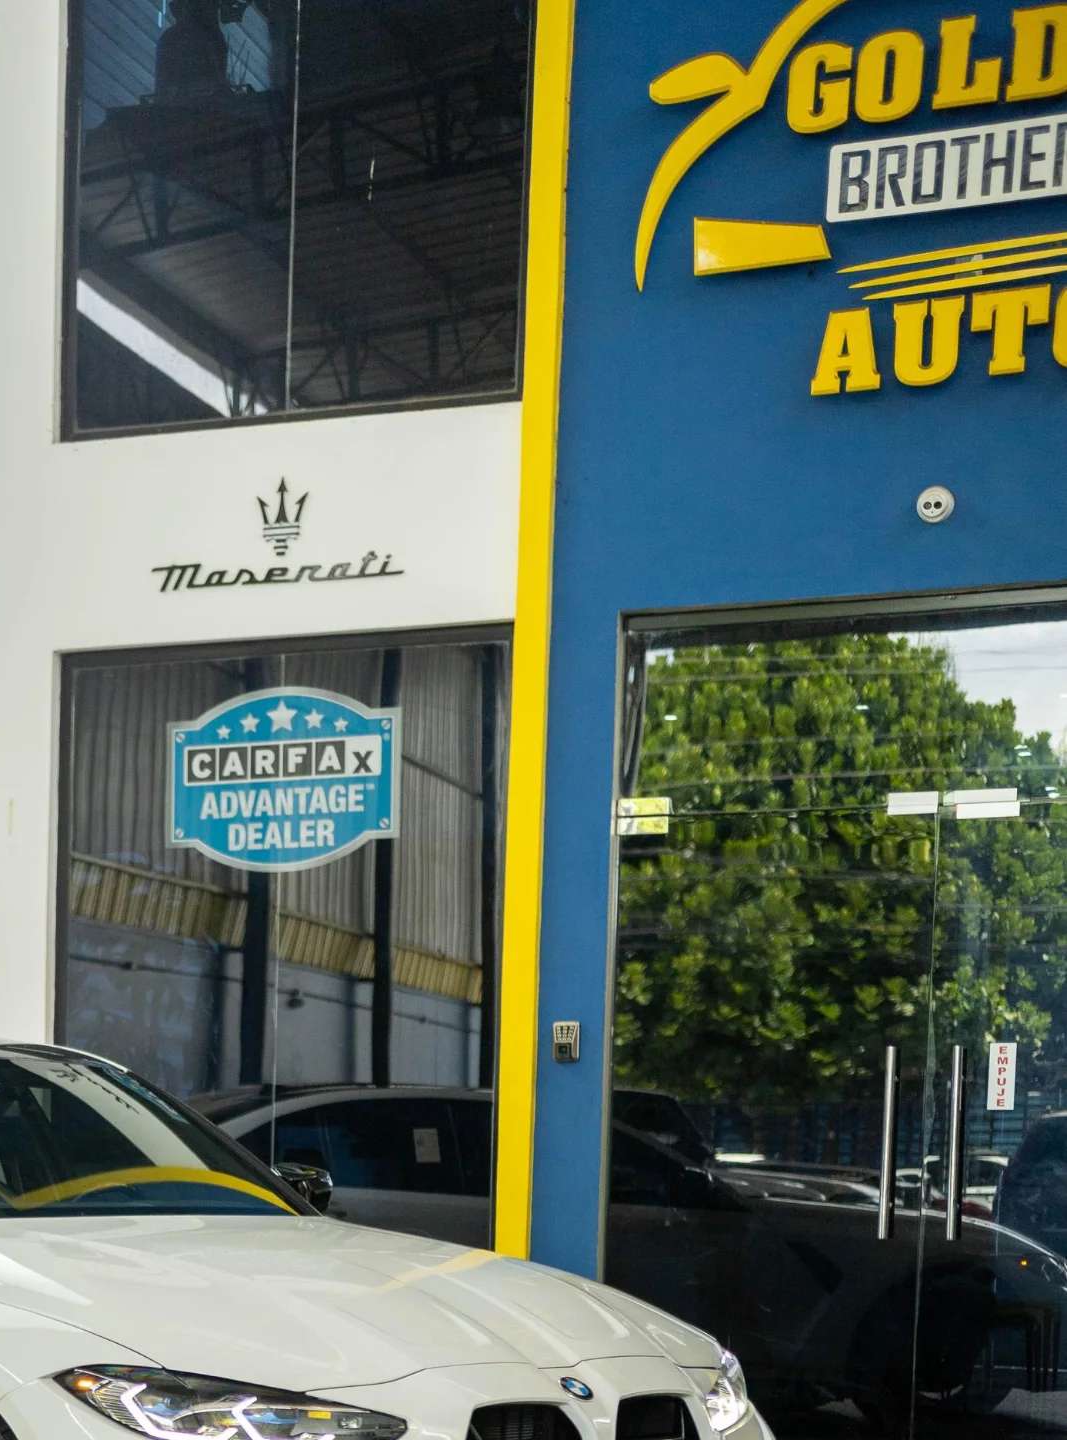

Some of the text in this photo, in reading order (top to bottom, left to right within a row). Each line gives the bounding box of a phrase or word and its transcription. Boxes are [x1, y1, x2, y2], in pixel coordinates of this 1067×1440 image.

[810, 283, 1067, 397] AUT
[151, 550, 405, 593] Maserati
[190, 746, 375, 780] CARFAX
[199, 783, 365, 821] ADVANTAGE
[227, 819, 335, 852] DEALER
[996, 1045, 1009, 1107] EMPUJE
